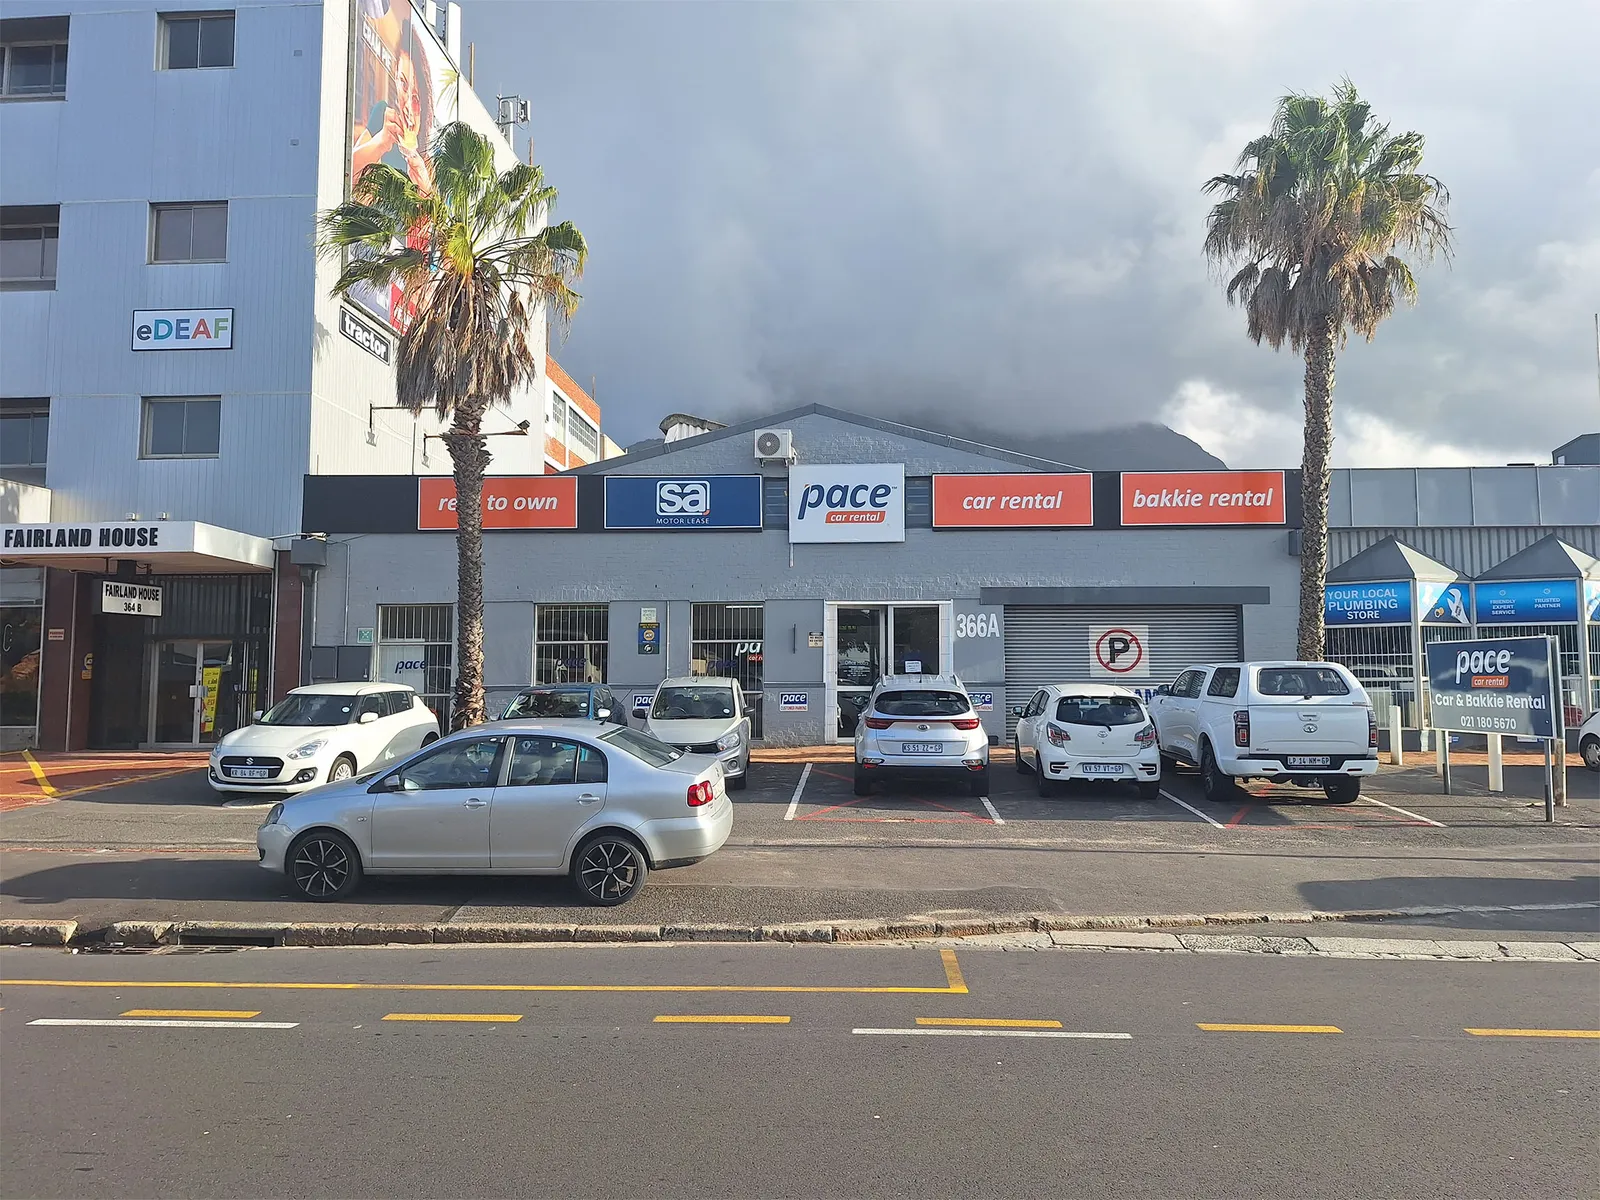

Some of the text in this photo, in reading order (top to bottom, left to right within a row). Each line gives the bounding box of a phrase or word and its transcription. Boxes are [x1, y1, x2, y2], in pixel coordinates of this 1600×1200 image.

[136, 318, 229, 341] eDEAF
[344, 313, 387, 358] tractor
[438, 494, 558, 511] re to own
[660, 484, 706, 513] sa
[797, 484, 892, 520] pace
[962, 491, 1063, 510] car rental
[1133, 488, 1273, 508] bakkie rental
[830, 512, 880, 522] car rental
[4, 527, 159, 548] FAIRLAND HOUSE
[105, 584, 160, 601] FAIRLAND HOUSE
[1327, 588, 1398, 600] YOUR LOCAL
[123, 602, 142, 613] 364 B
[1328, 599, 1398, 611] PLUMBING
[1347, 610, 1380, 620] STORE
[956, 613, 1000, 638] 366A
[1108, 637, 1130, 663] P
[394, 660, 427, 674] pace
[1455, 649, 1511, 684] pace
[1474, 677, 1505, 686] car rental
[634, 696, 655, 706] pac
[781, 694, 806, 705] pace
[1435, 693, 1546, 710] Car & Bakkie Rental
[1460, 715, 1517, 730] 021 180 5670
